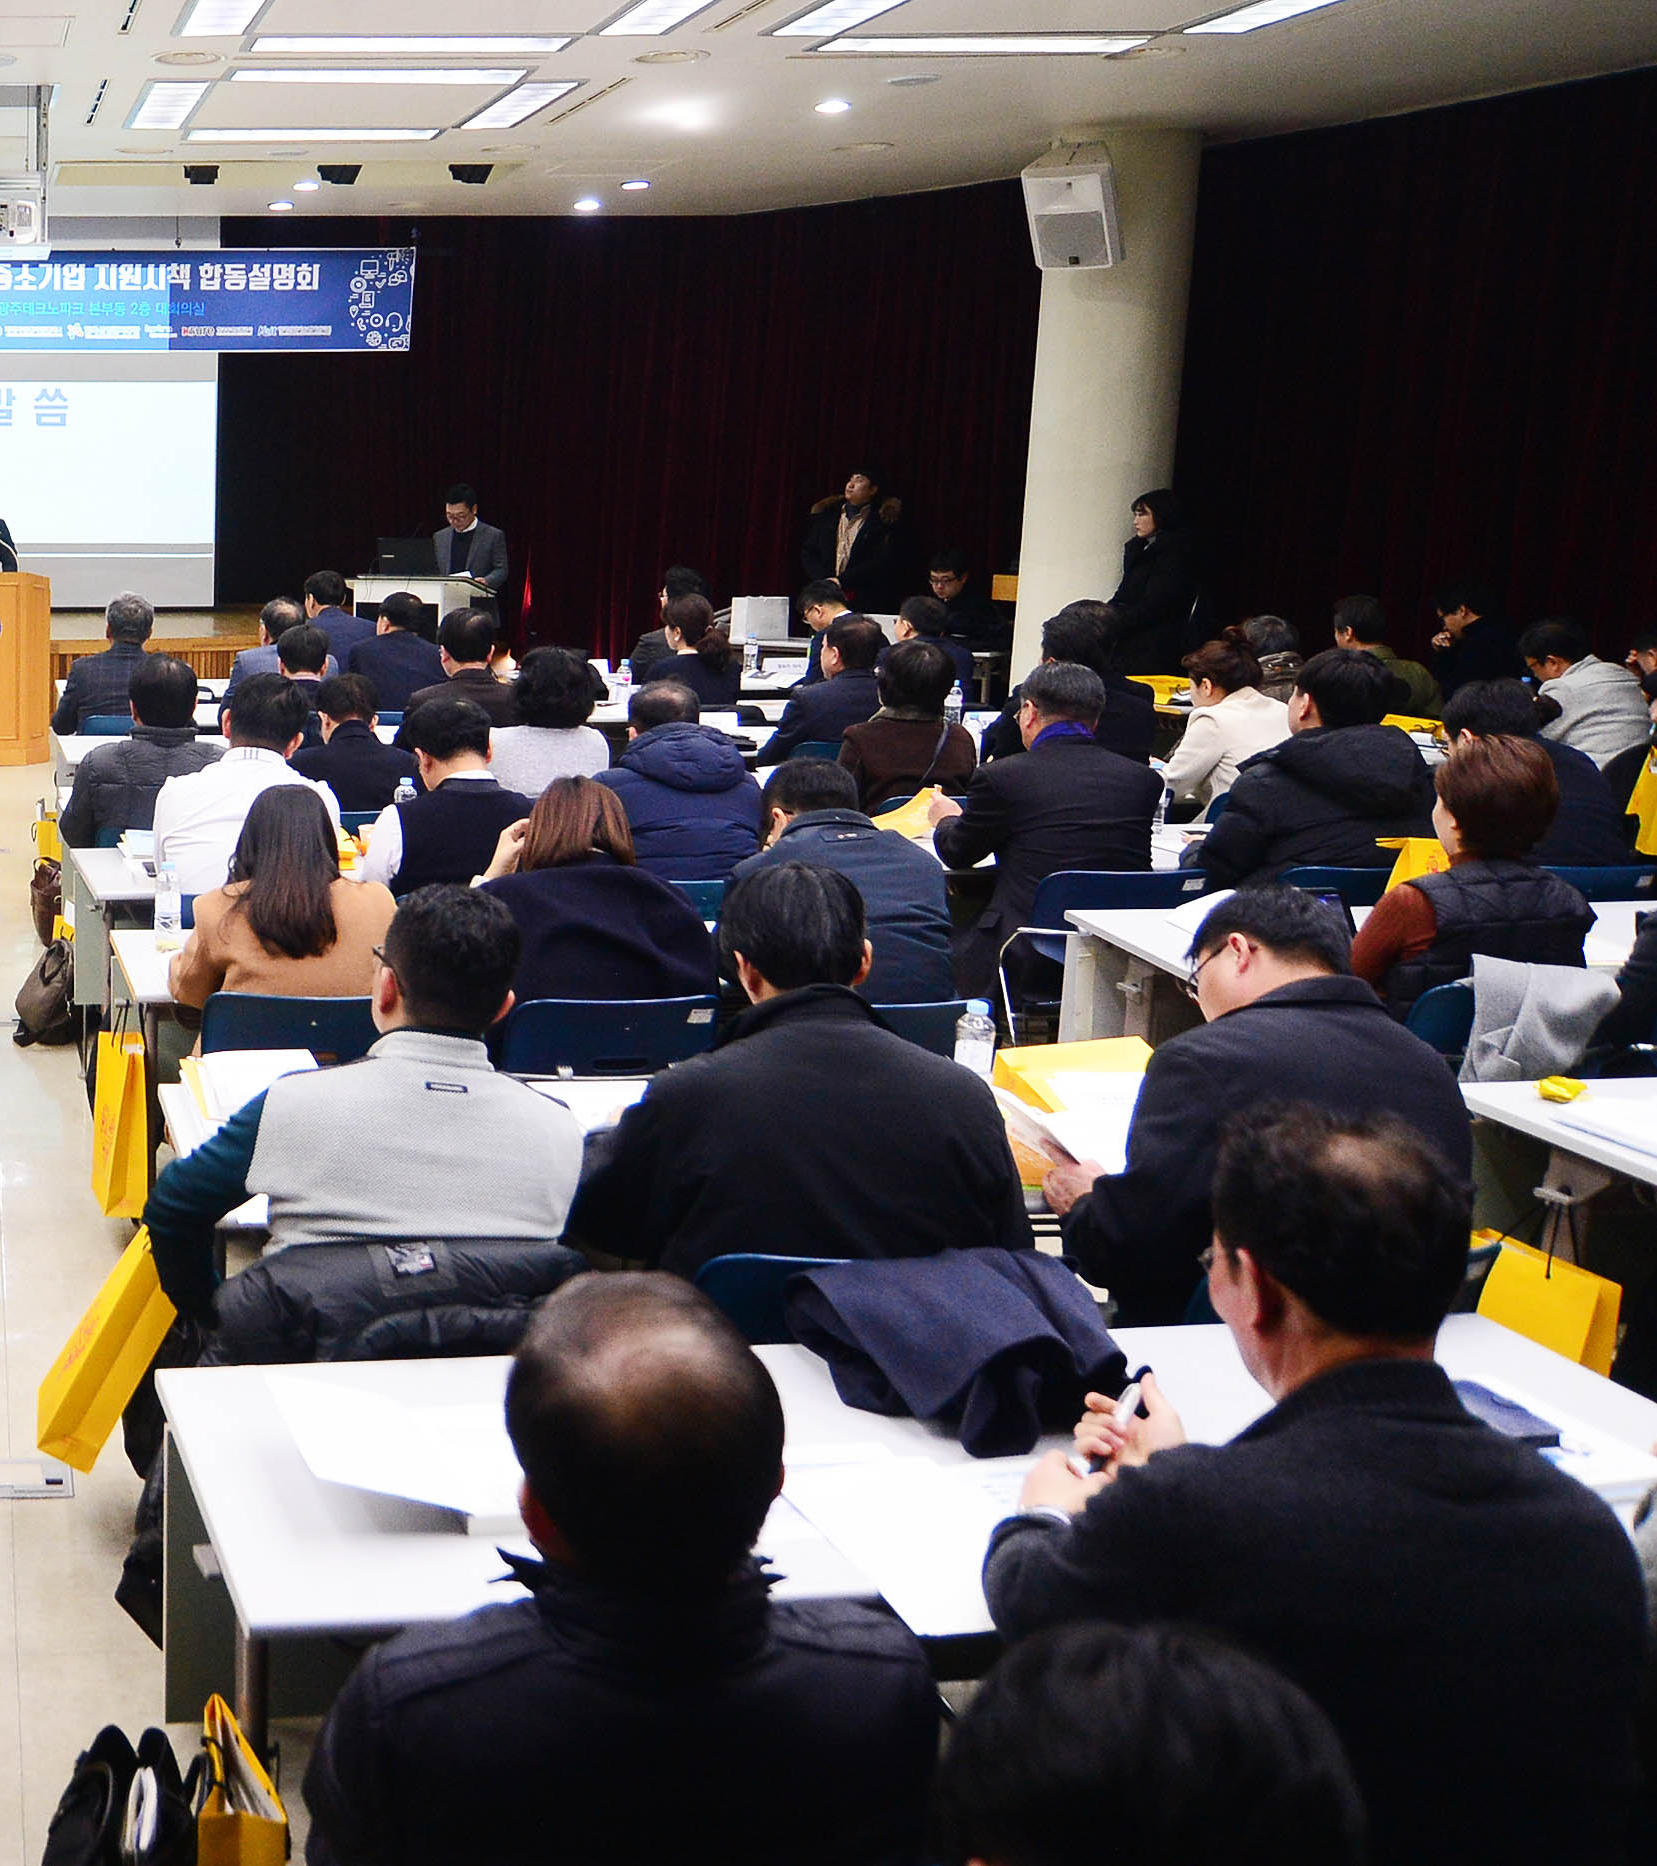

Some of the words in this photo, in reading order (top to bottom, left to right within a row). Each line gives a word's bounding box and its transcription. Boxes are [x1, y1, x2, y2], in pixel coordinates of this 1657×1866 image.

[94, 263, 191, 291] 지원시책
[198, 263, 320, 291] 합동설명회
[89, 302, 126, 316] 본부동
[155, 302, 205, 316] 대회의실
